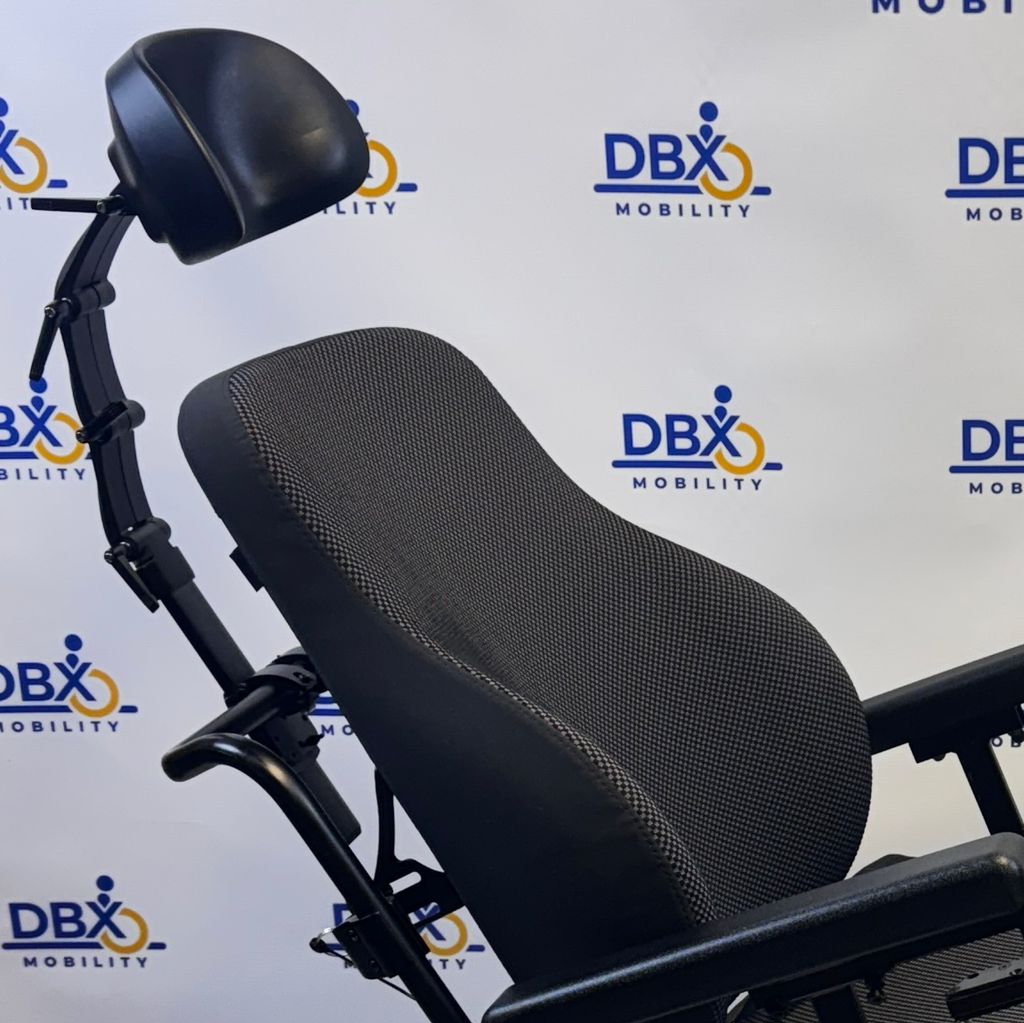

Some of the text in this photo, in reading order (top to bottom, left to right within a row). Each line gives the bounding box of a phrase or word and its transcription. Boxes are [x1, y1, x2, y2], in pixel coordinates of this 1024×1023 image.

[605, 134, 728, 181] DBX
[324, 202, 395, 215] LITY
[616, 203, 749, 217] MOBILITY
[0, 405, 62, 447] BX
[623, 414, 741, 457] DBX
[0, 468, 85, 480] BILITY
[633, 477, 761, 490] MOBILITY
[0, 721, 118, 732] OBILITY
[9, 902, 126, 939] DBX
[23, 957, 146, 968] MOBILITY
